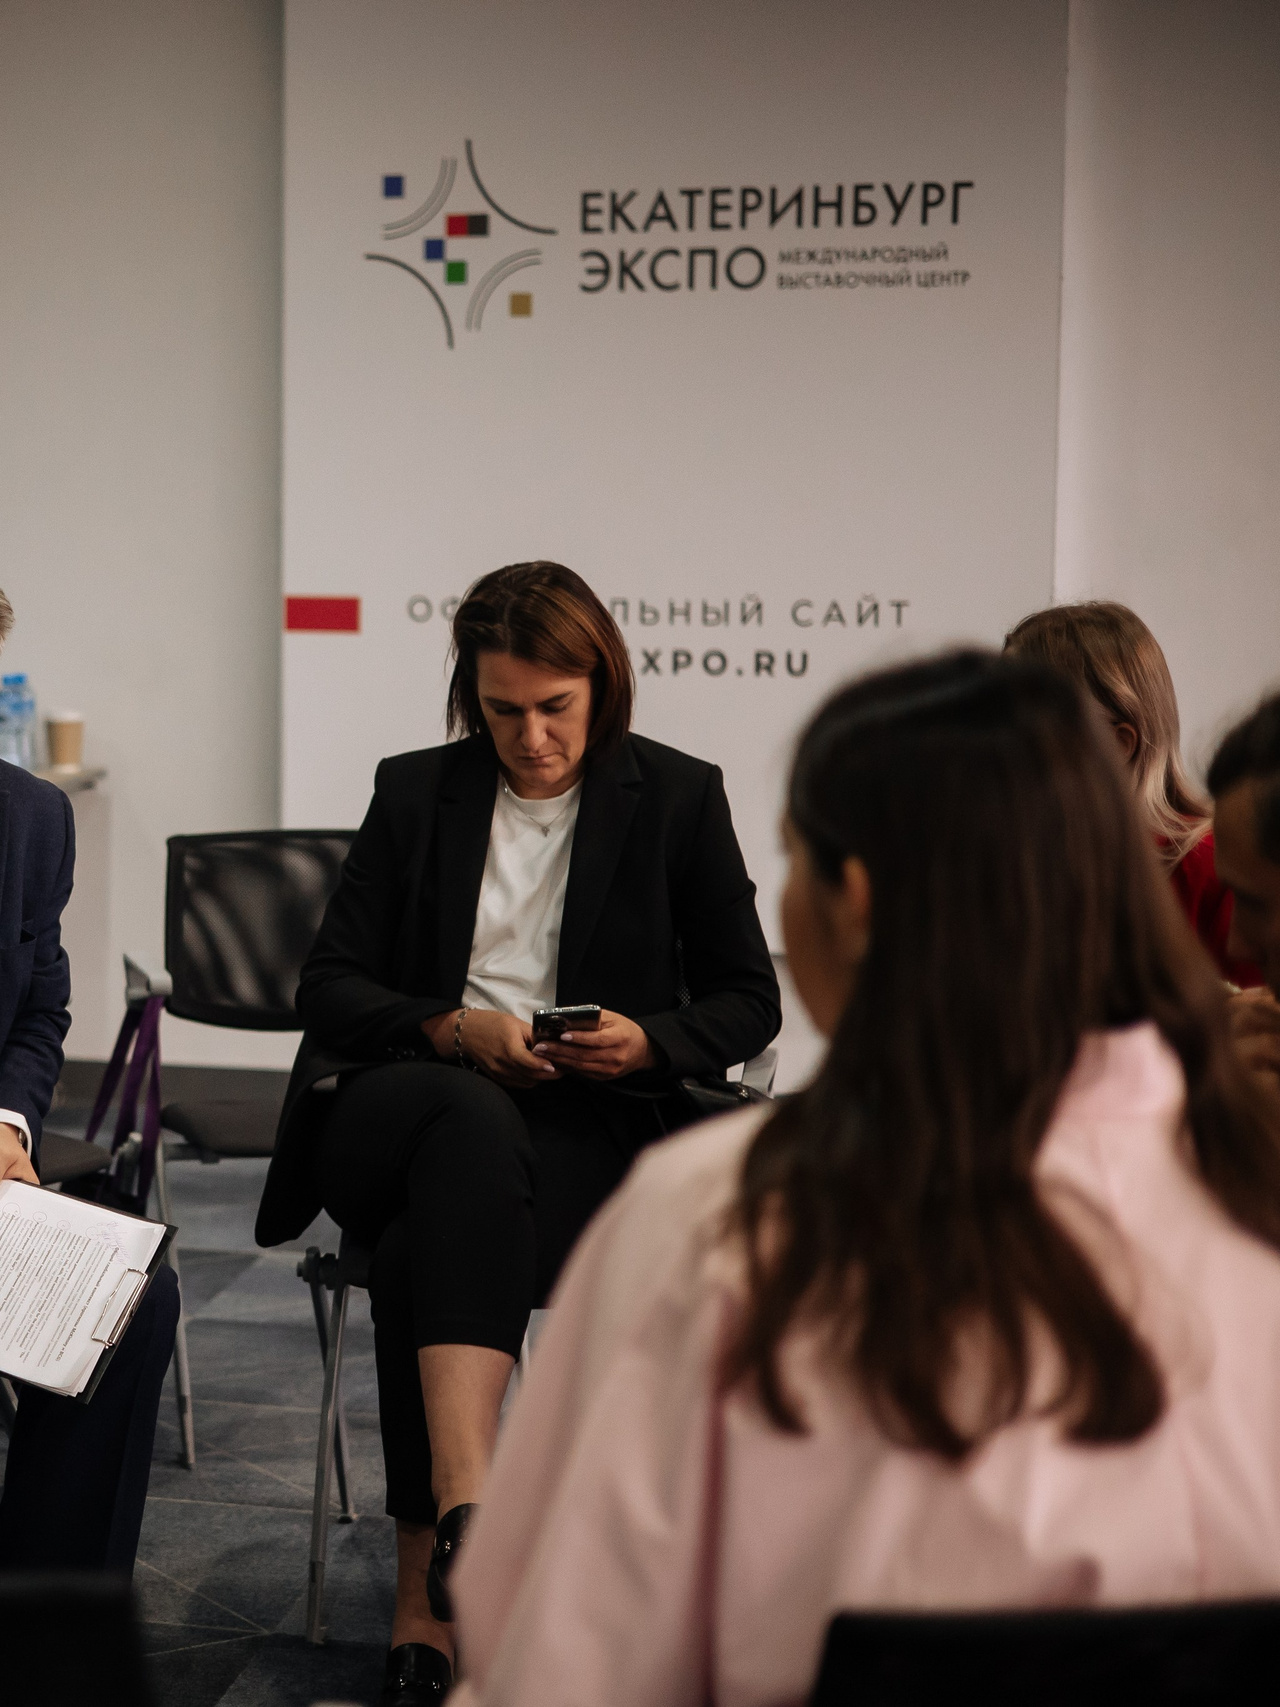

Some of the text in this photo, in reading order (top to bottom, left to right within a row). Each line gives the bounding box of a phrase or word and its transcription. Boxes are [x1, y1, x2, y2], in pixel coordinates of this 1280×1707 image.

[580, 181, 974, 233] ЕКАТЕРИНБУРГ
[579, 245, 766, 291] ЭКСПО
[777, 241, 949, 265] МЕЖДУНАРОДНЫЙ
[776, 268, 971, 290] ВЫСТАВОЧНЫЙ ЦЕНТР
[791, 593, 911, 627] САЙТ
[640, 648, 809, 677] XPO.RU
